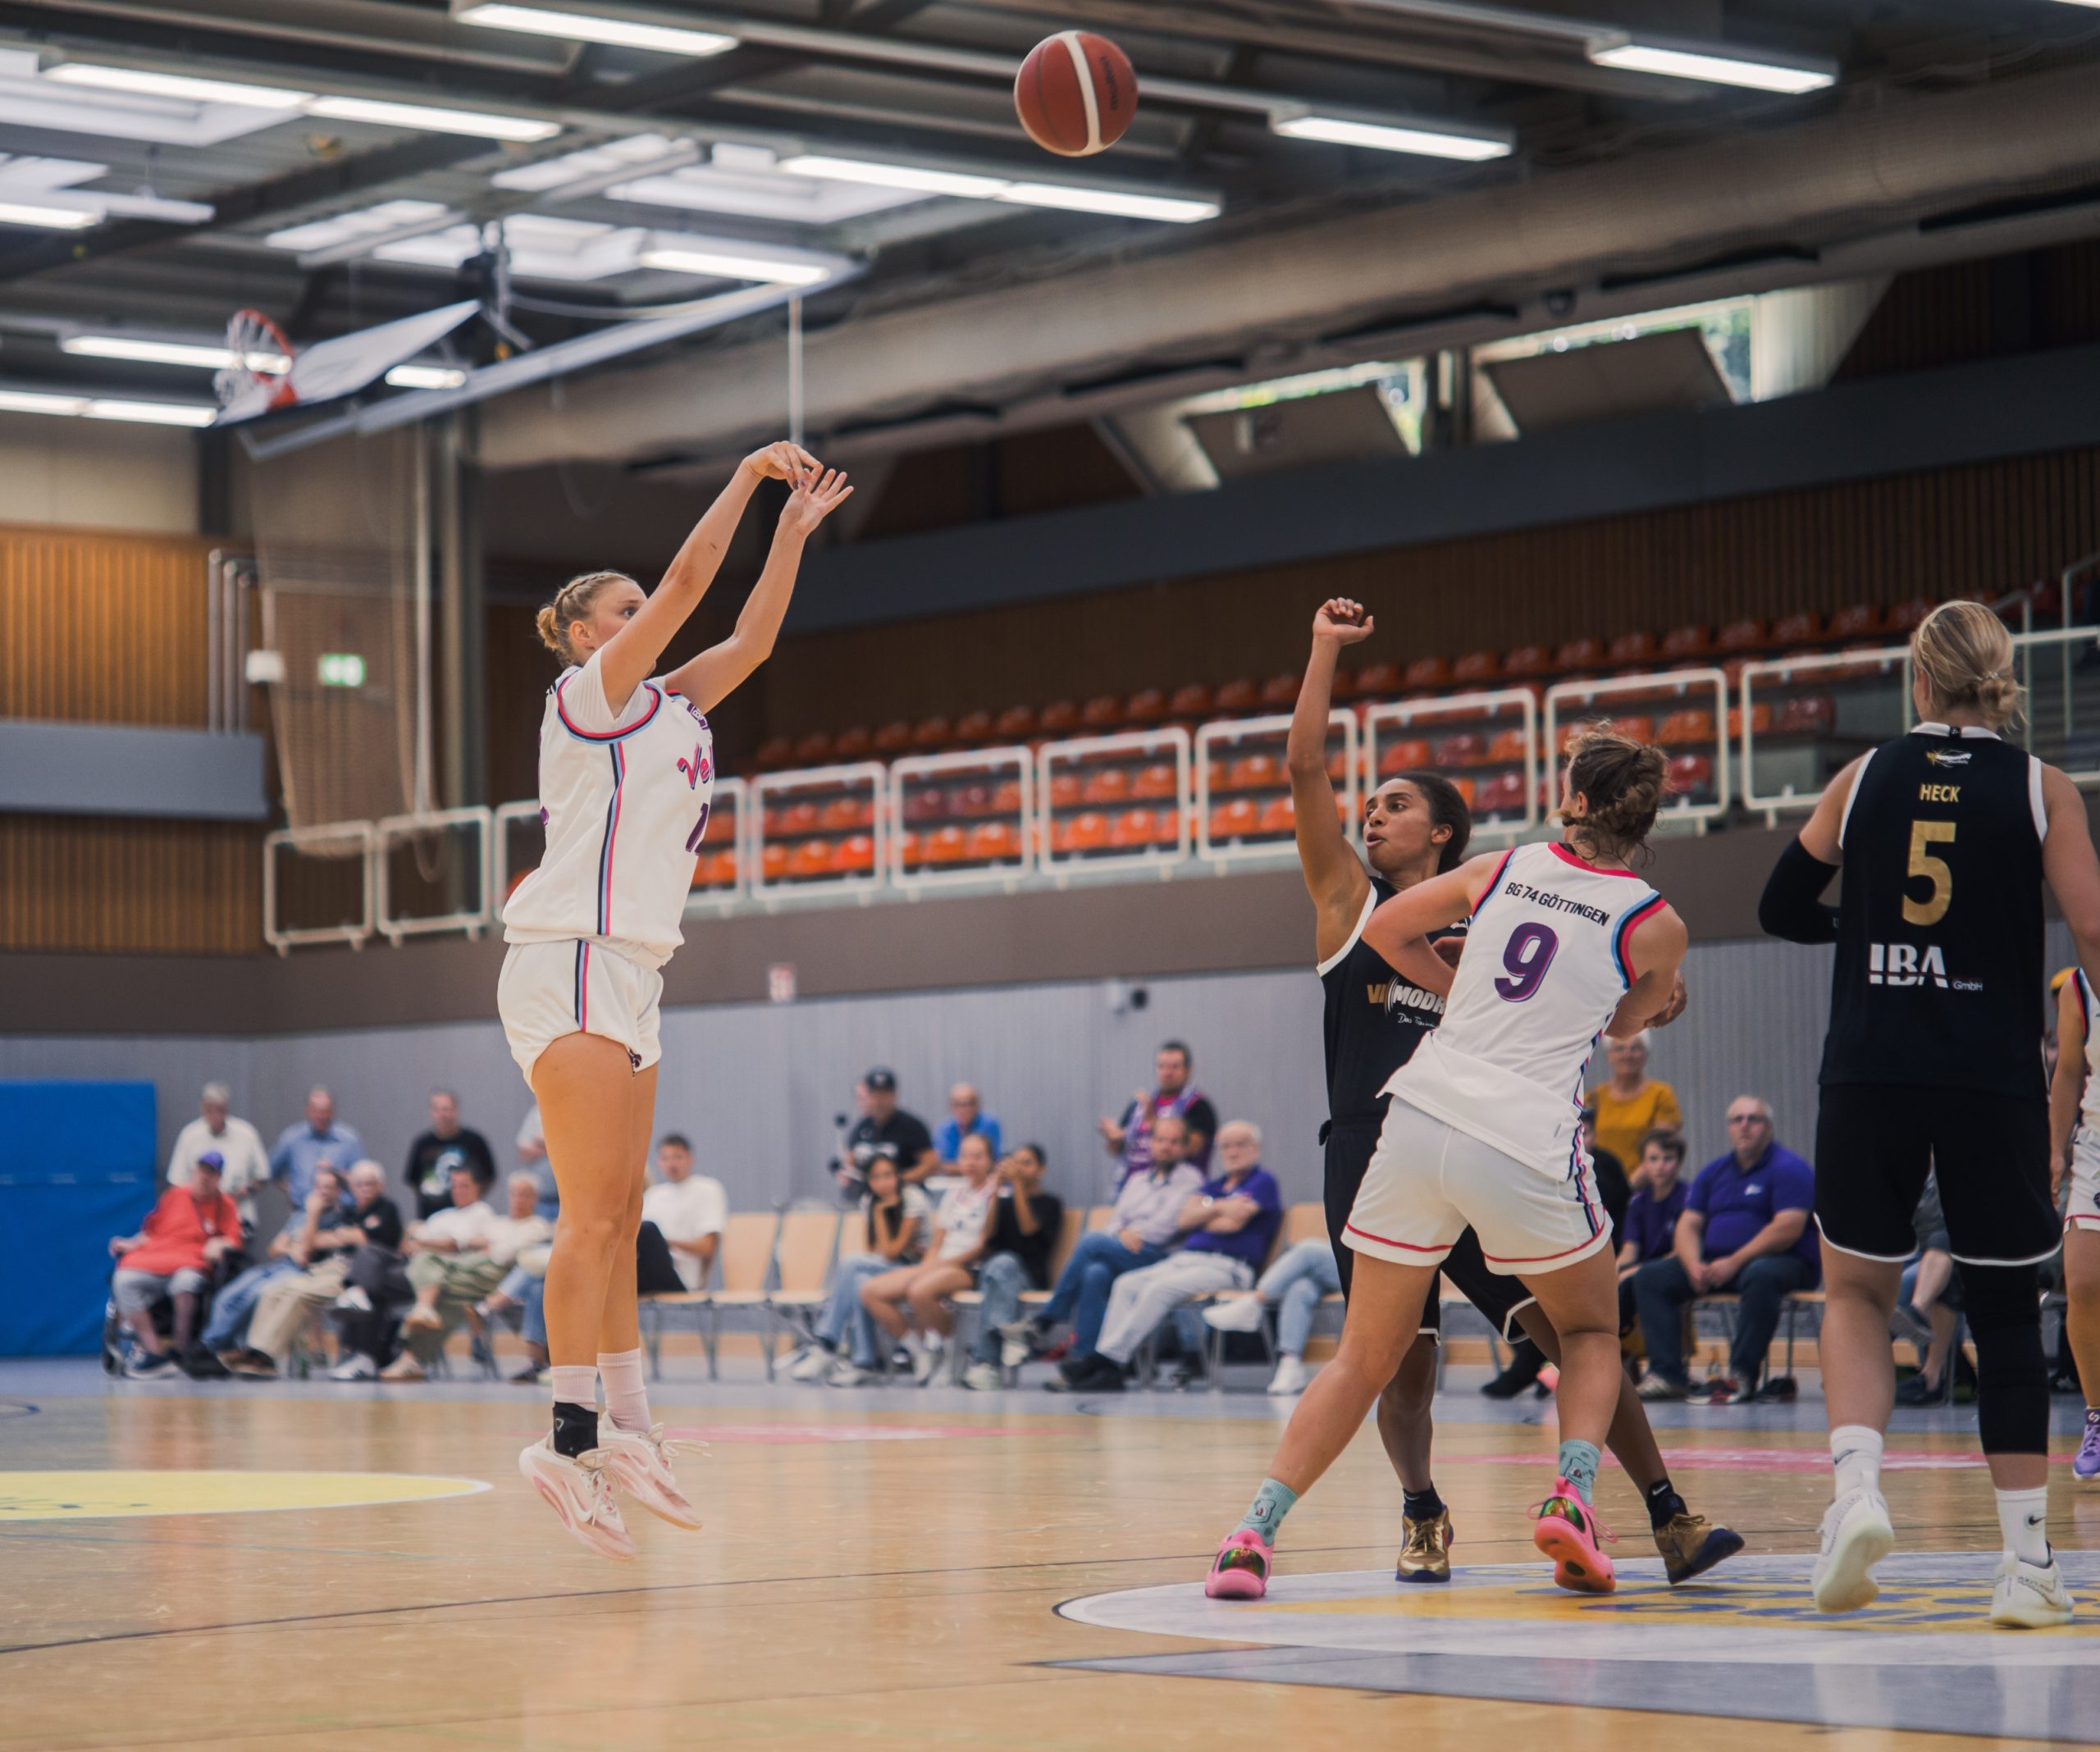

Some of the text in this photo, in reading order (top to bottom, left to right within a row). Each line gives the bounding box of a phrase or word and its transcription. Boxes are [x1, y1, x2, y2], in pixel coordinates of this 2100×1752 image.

[1920, 782, 1961, 803] HECK
[1902, 820, 1956, 925] 5
[1504, 882, 1610, 927] BG 74 GÖTTINGEN
[1495, 922, 1559, 1002] 9
[1869, 943, 1949, 988] IBA
